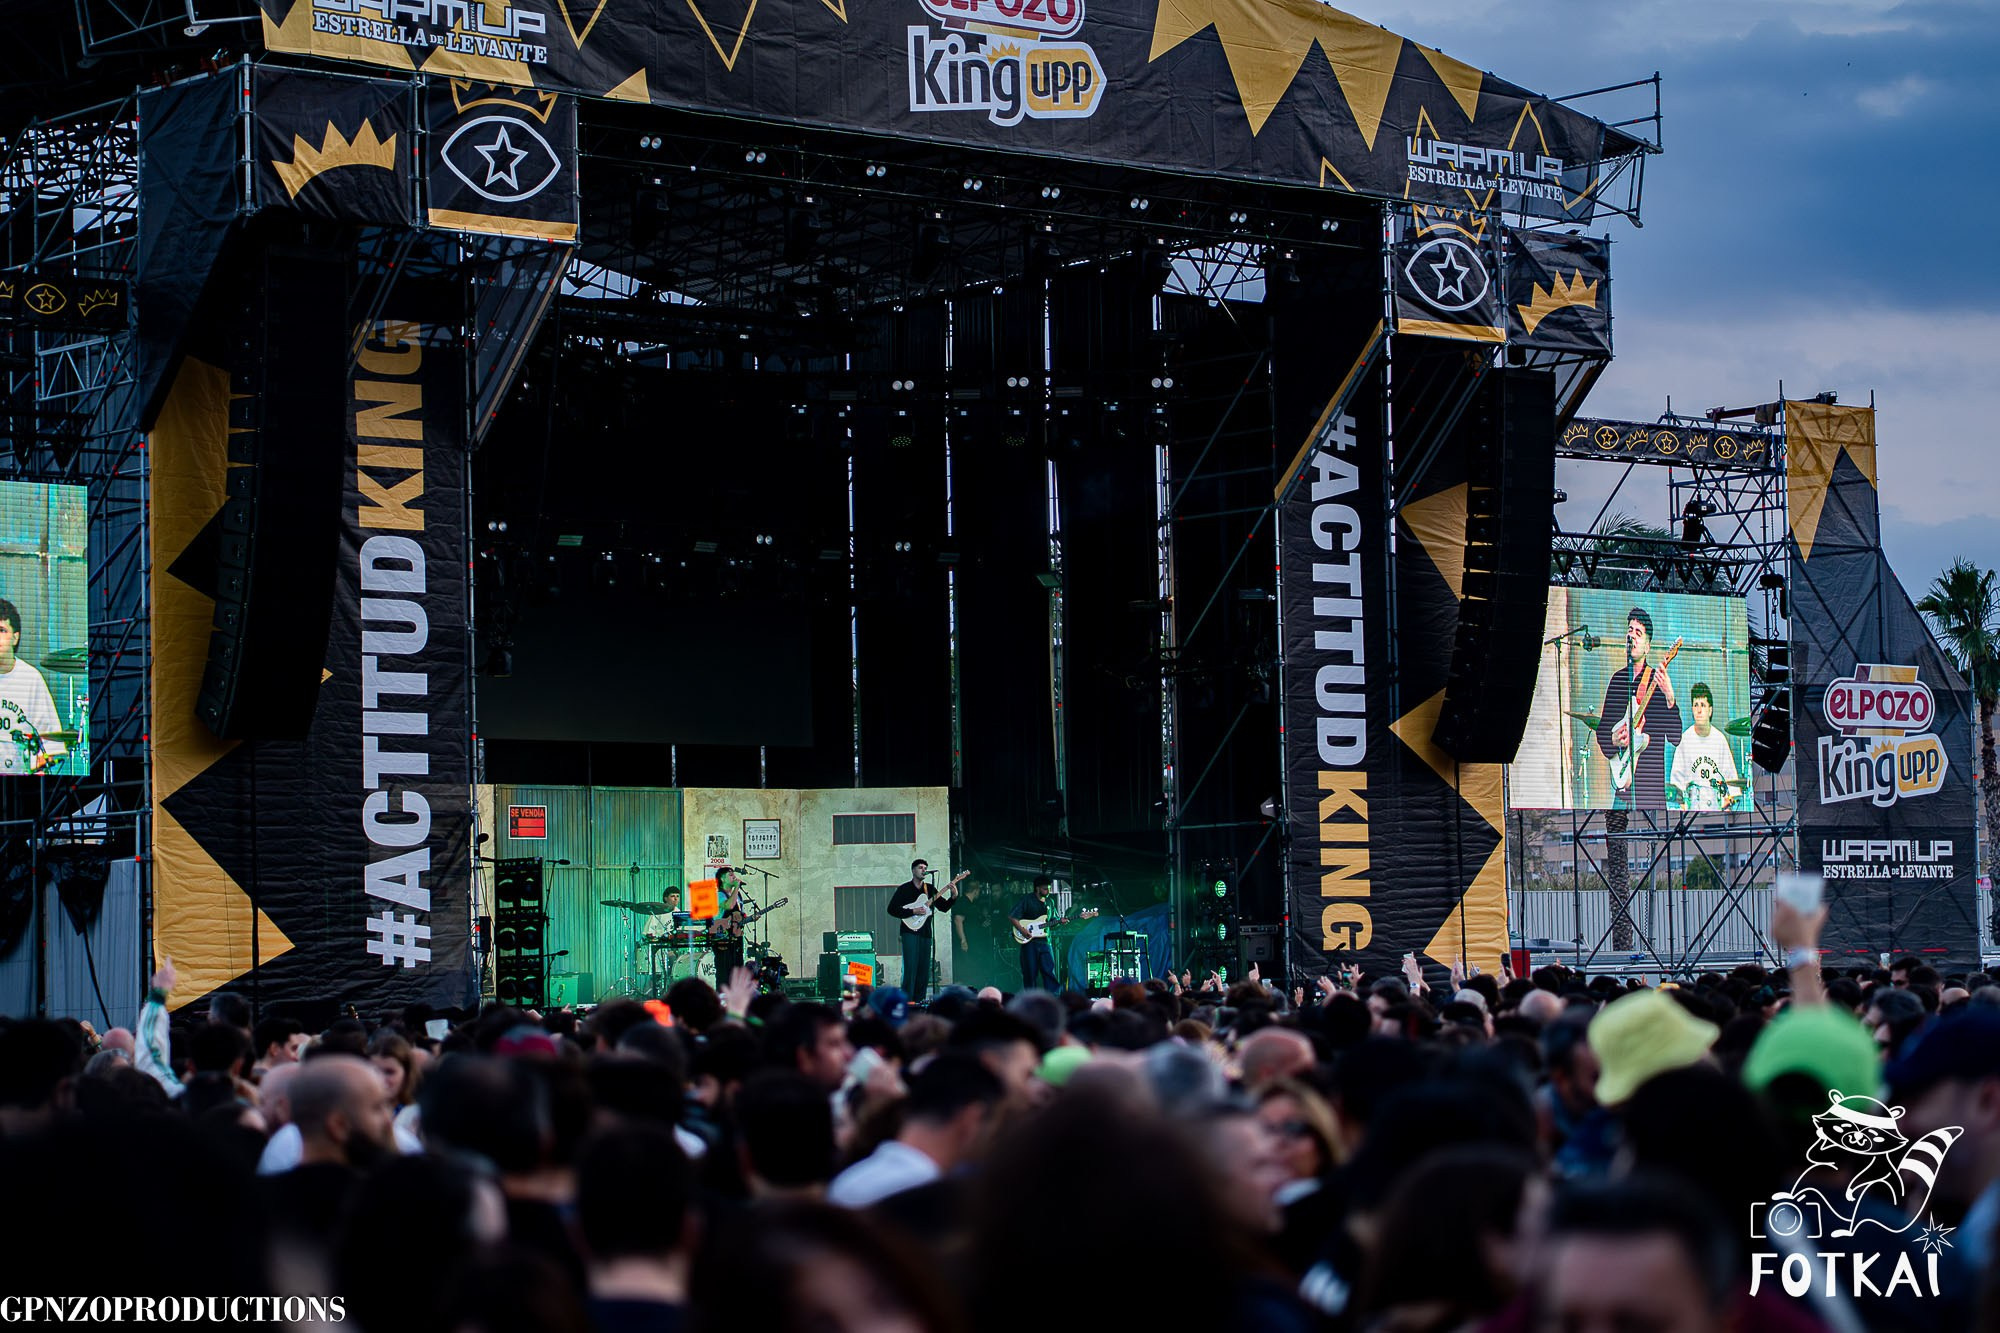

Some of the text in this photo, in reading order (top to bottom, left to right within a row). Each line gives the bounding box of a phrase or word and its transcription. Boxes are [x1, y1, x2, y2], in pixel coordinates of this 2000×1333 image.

[478, 3, 546, 36] UP
[313, 12, 547, 64] ESTRELLA DE LEVANTE
[913, 34, 1092, 119] king upp
[1407, 136, 1563, 179] WARM UP
[1408, 165, 1563, 202] ESTRELLA DE LEVANTE
[1700, 769, 1710, 779] 90
[1821, 743, 1940, 801] king upp
[510, 808, 519, 818] SE
[1822, 840, 1953, 862] WARM UP
[1822, 864, 1954, 879] ESTRELLA DE LEVANTE
